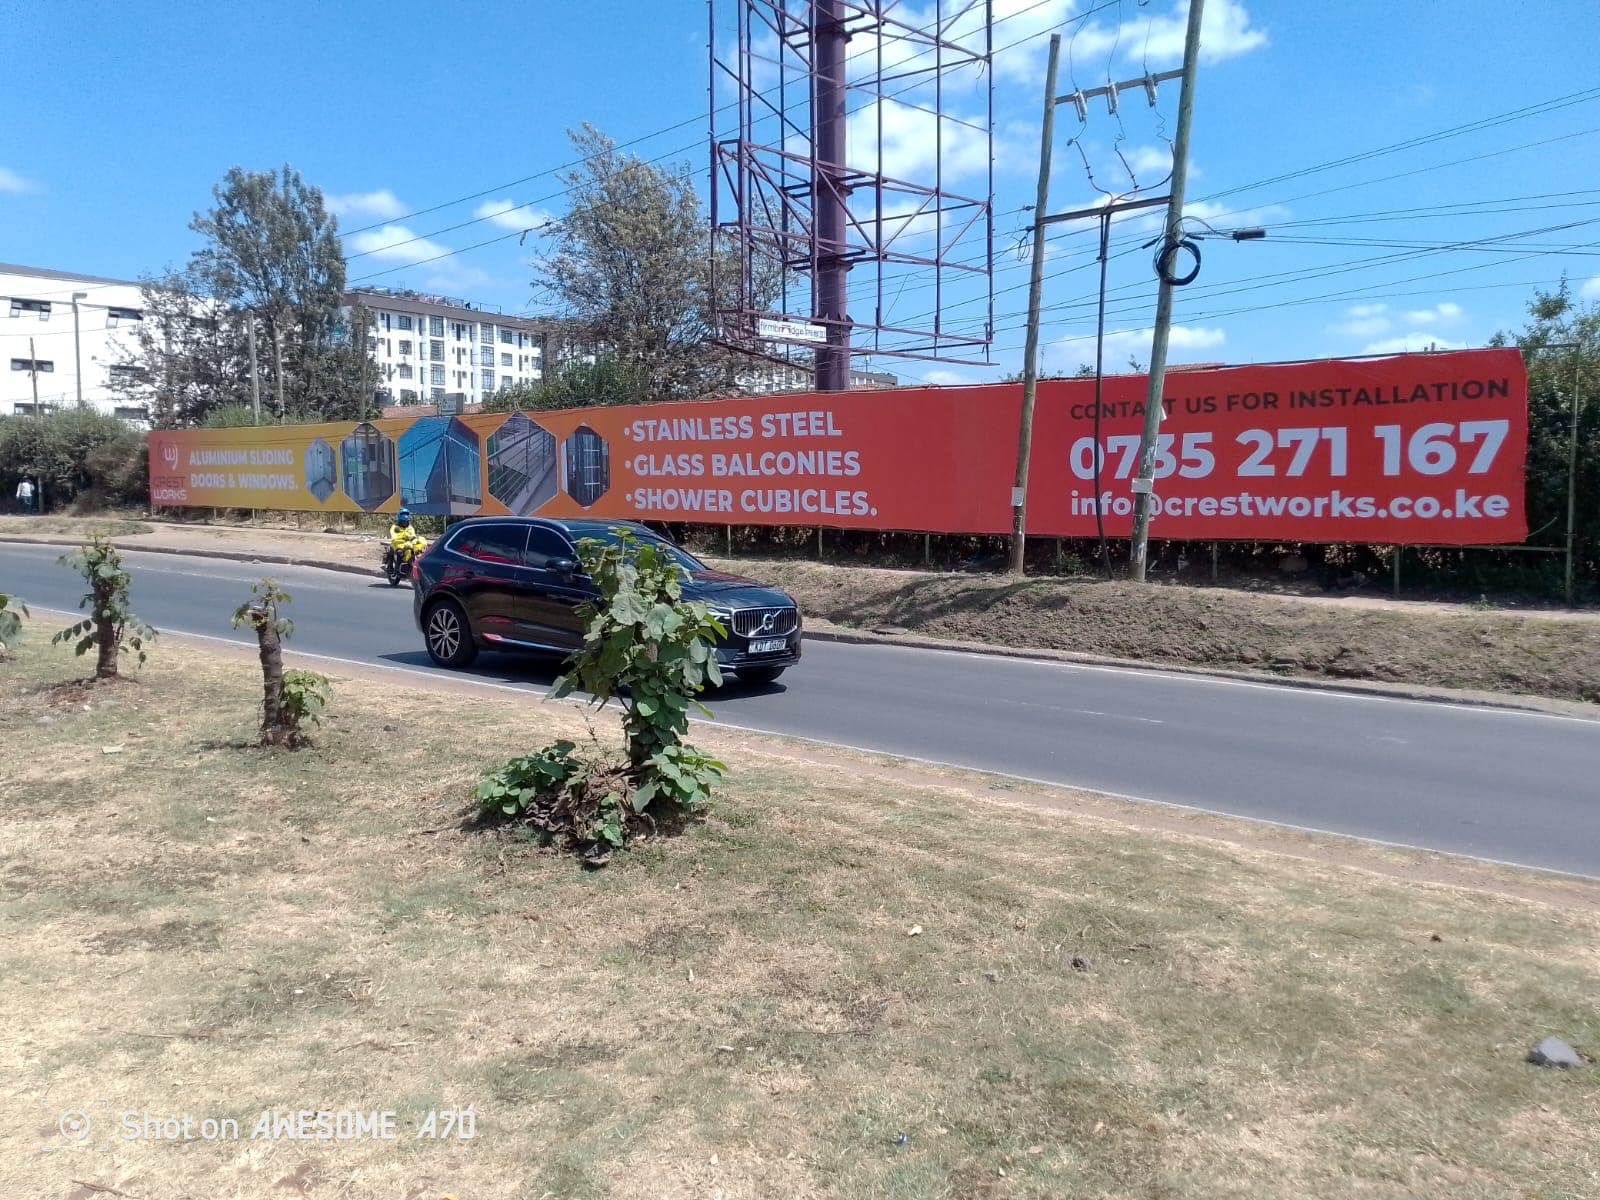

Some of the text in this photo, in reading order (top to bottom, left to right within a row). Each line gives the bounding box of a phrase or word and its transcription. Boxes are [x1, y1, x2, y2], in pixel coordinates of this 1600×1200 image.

[1070, 378, 1509, 420] CONTAT US FOR INSTALLATION
[761, 411, 843, 438] STEEL
[189, 449, 294, 466] ALUMINIUM SLIDING
[1235, 426, 1348, 478] 271
[1373, 419, 1509, 477] 167
[711, 450, 861, 477] BALCONIES
[153, 488, 188, 501] WORKS
[191, 473, 299, 491] DOORS & WINDOWS.
[740, 488, 878, 517] CUBICLES.
